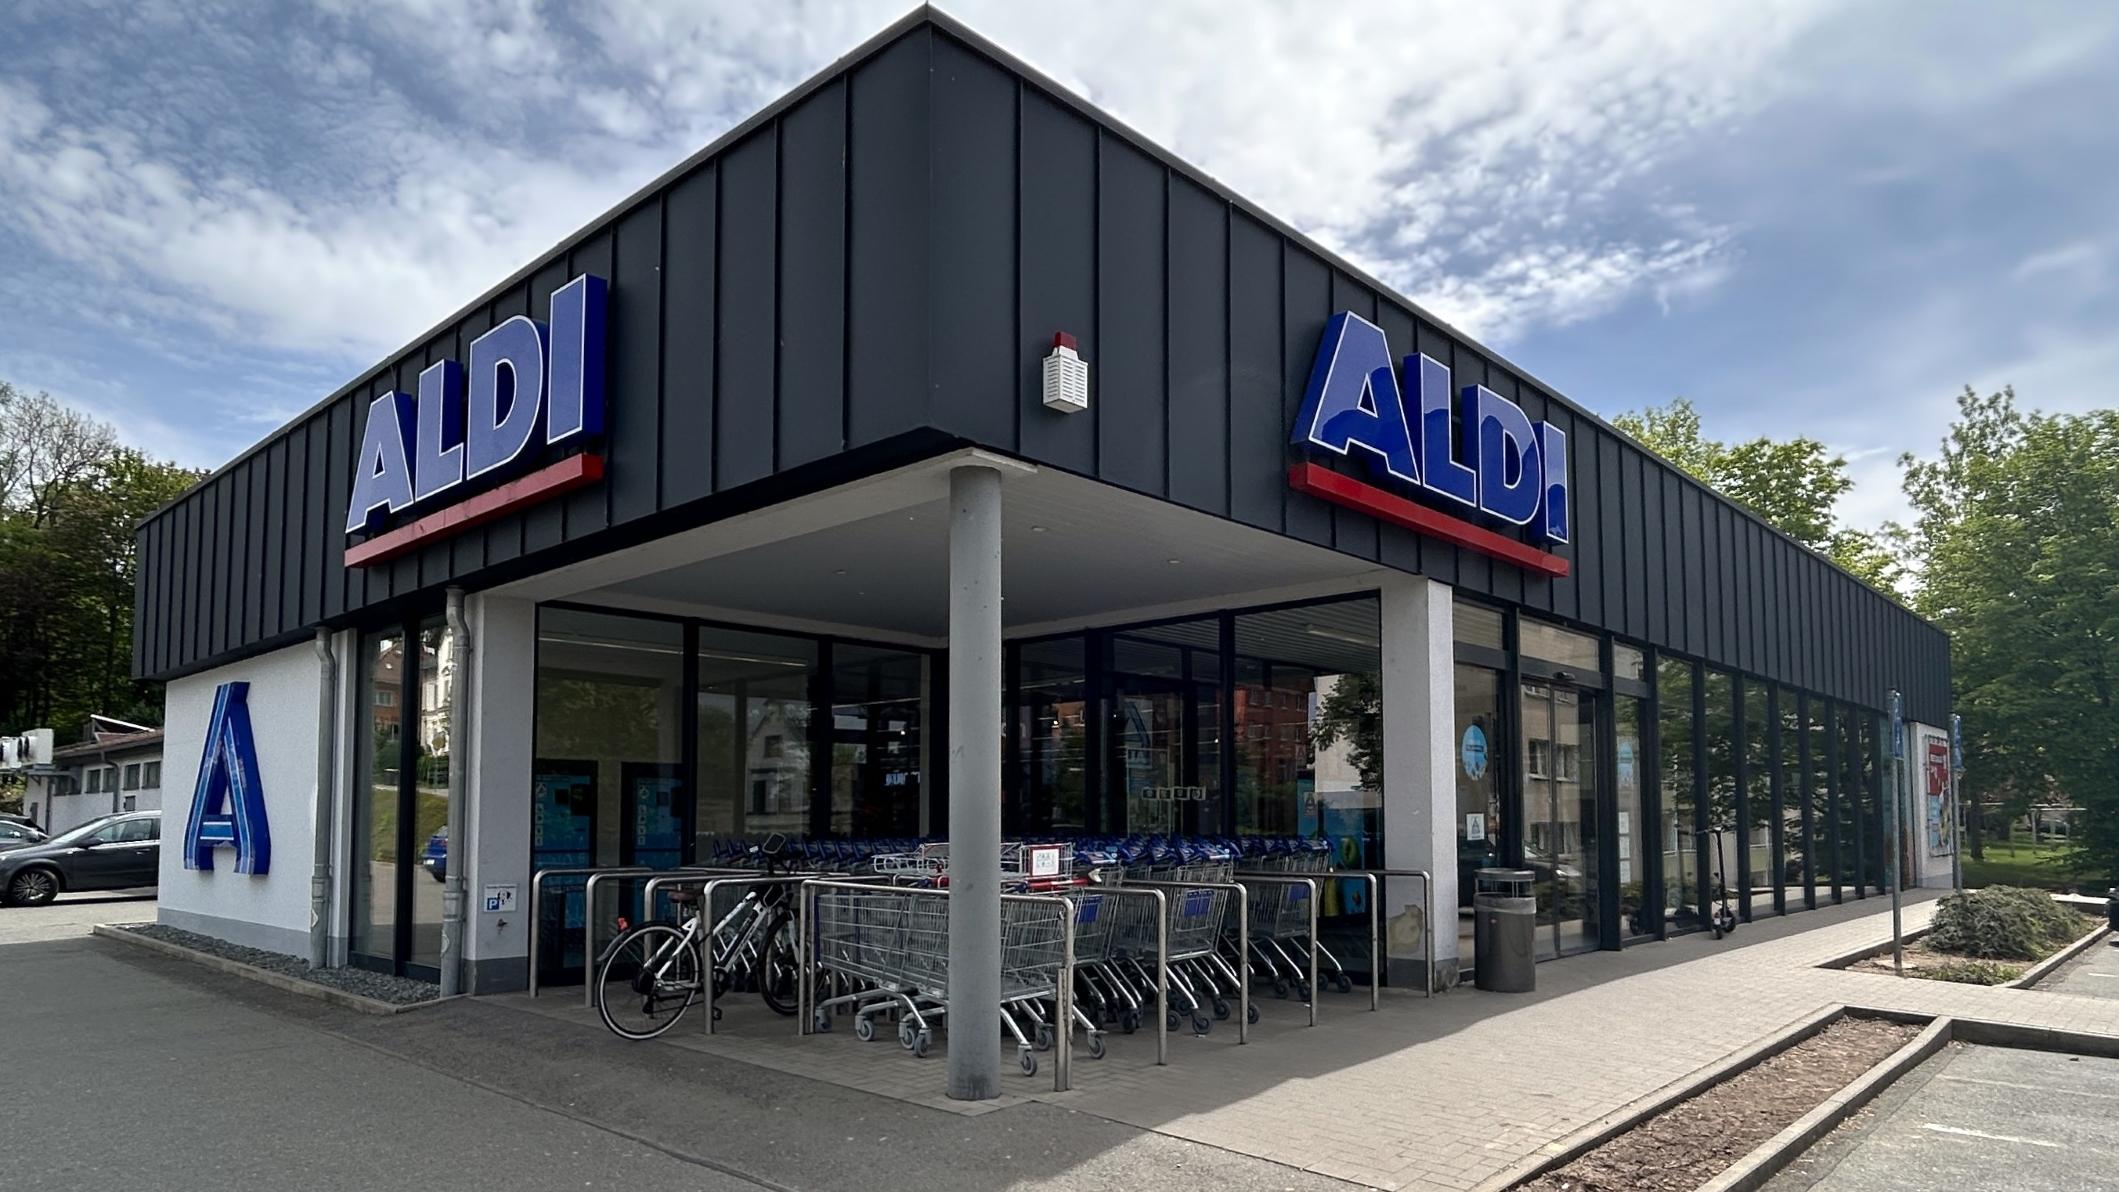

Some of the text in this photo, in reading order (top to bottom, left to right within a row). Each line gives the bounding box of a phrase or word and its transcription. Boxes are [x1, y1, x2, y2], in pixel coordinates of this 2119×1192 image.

[346, 273, 600, 534] ALDI
[1302, 310, 1569, 544] ALDI
[184, 682, 271, 875] A
[489, 899, 498, 910] P
